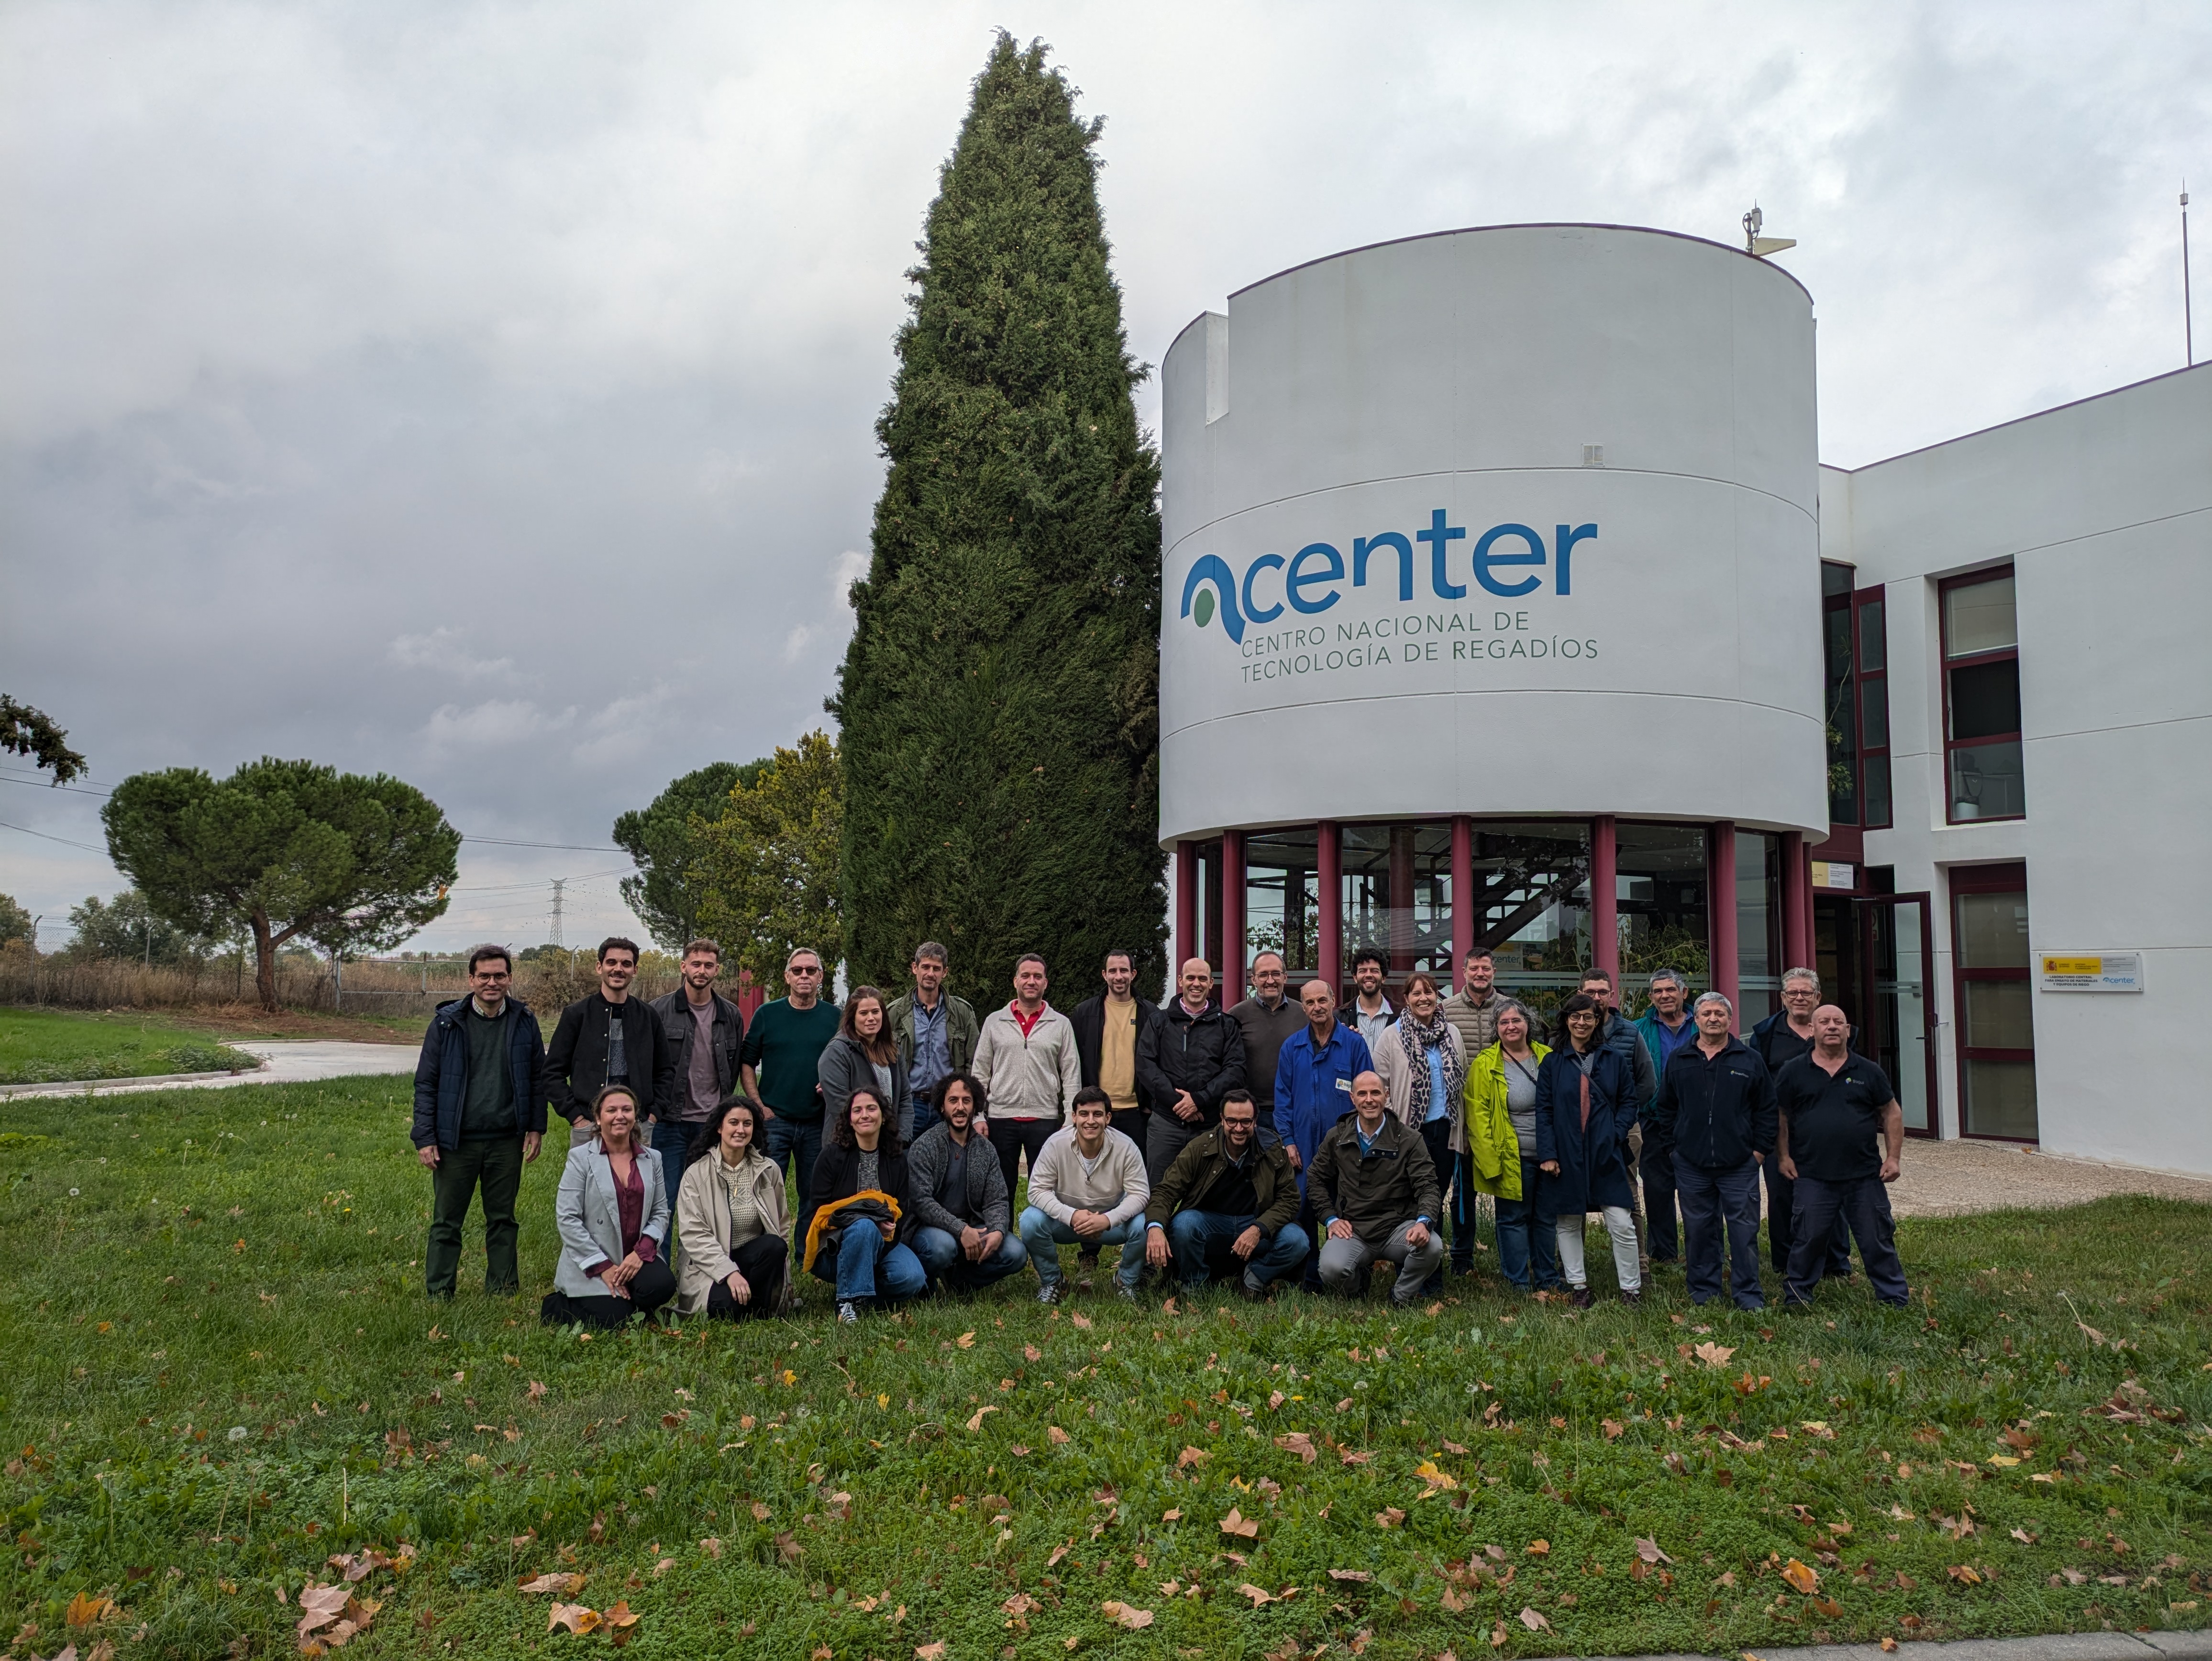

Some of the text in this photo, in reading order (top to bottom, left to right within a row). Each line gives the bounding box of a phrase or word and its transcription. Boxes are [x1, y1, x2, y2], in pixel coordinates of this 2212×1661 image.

[1242, 611, 1529, 658] CENTRO NACIONAL DE
[1241, 635, 1598, 683] TECNOLOGÍA DE REGADÍOS
